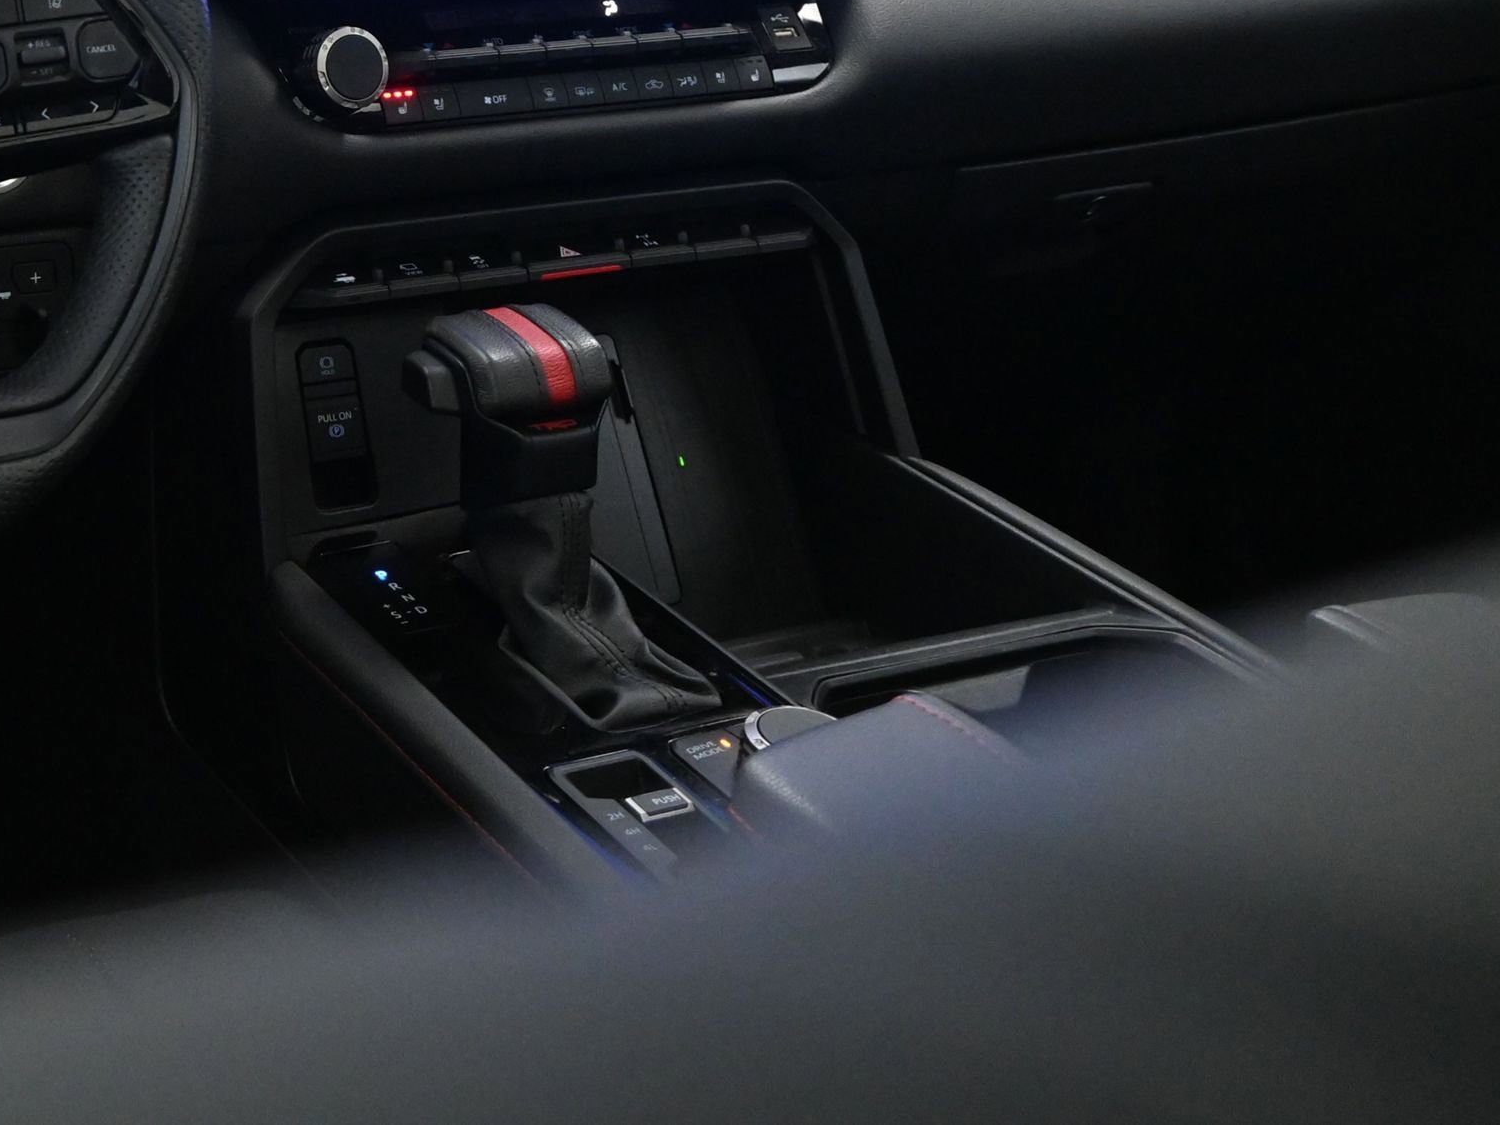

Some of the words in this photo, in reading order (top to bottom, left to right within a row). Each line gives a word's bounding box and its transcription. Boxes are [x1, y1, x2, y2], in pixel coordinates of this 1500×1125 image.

[86, 44, 116, 54] CANCEL
[612, 83, 628, 92] A/C
[493, 94, 508, 104] OFF
[317, 413, 337, 423] PULL
[339, 411, 352, 421] ON
[388, 582, 403, 591] R
[401, 593, 416, 602] N
[390, 611, 402, 619] S
[414, 606, 428, 614] D
[686, 740, 718, 755] DRIVE
[692, 746, 725, 761] MODE
[652, 794, 681, 806] PUSH
[607, 811, 625, 821] 2H
[625, 827, 642, 836] 4H
